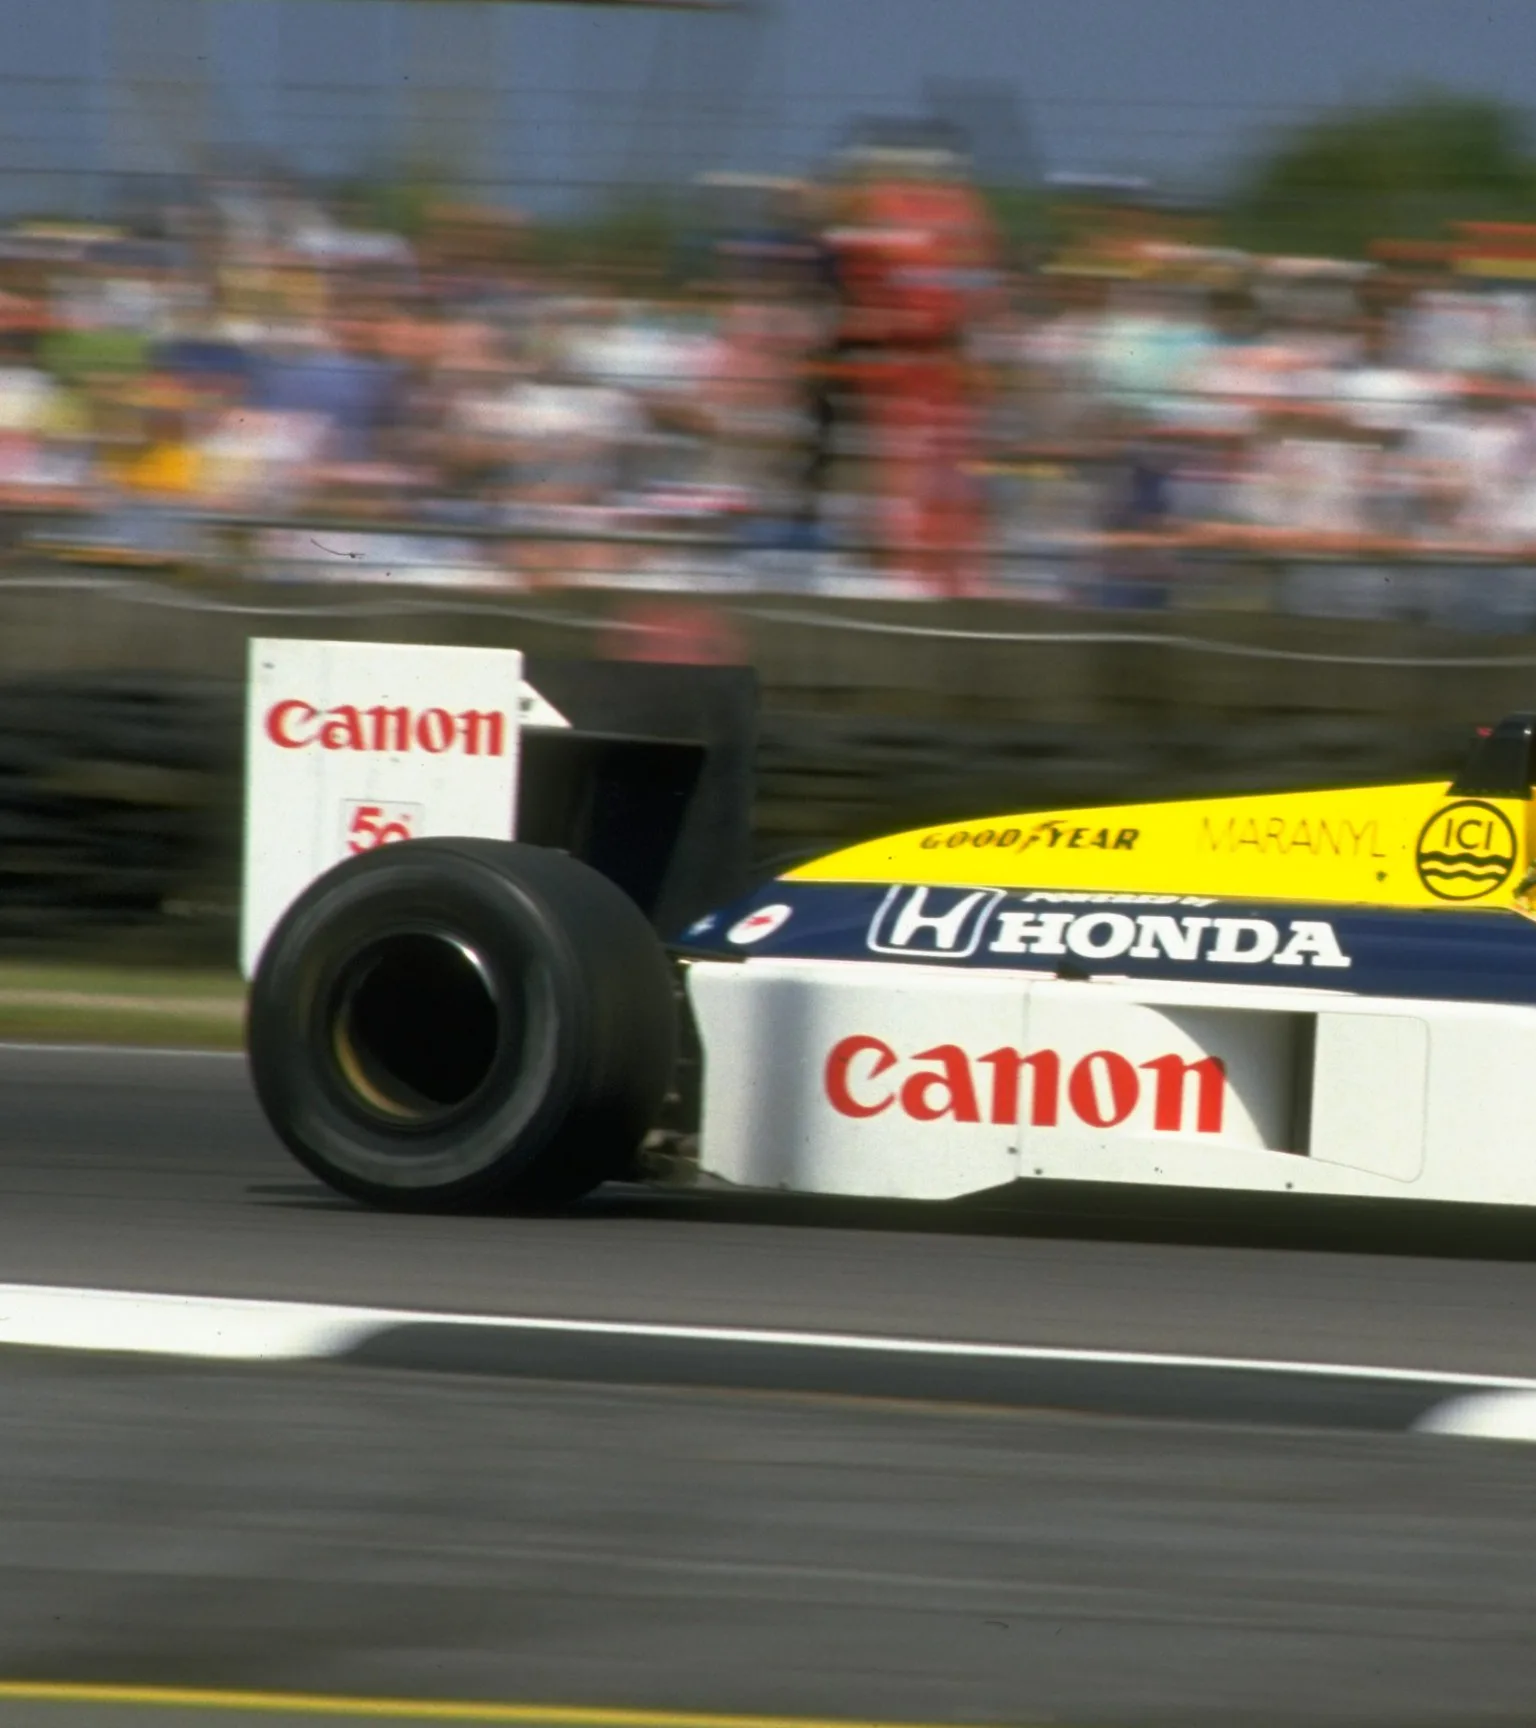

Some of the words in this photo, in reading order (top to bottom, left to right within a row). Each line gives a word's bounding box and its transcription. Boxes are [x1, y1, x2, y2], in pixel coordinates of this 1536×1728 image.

[265, 699, 505, 757] Canon
[1200, 817, 1387, 858] MARANYL
[1444, 818, 1494, 851] ICI
[989, 912, 1351, 968] HONDA
[824, 1034, 1227, 1133] Canon
